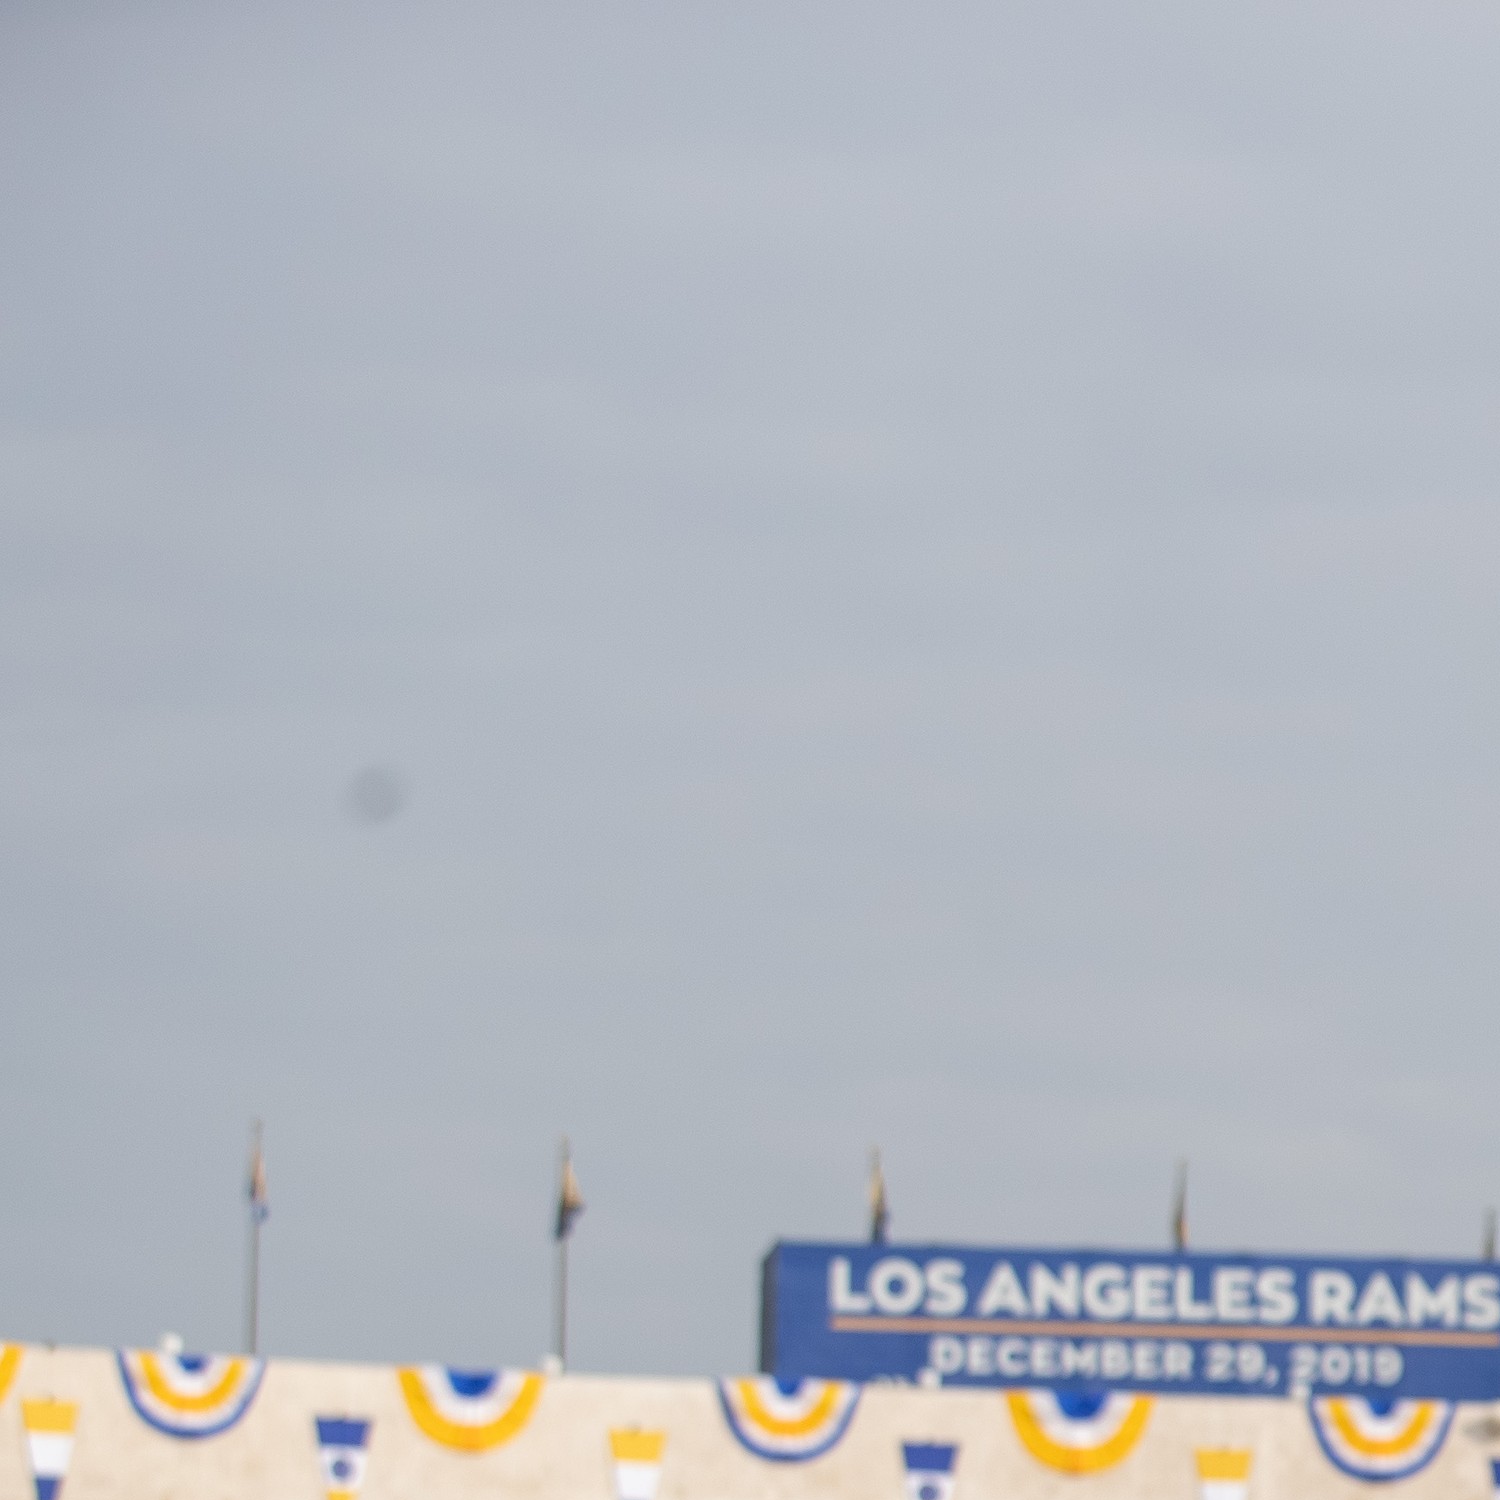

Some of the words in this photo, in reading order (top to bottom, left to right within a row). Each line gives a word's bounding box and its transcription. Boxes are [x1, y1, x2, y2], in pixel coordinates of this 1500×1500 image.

[829, 1257, 965, 1316] LOS
[979, 1261, 1298, 1325] ANGELES
[931, 1337, 1194, 1381] DECEMBER
[1207, 1342, 1279, 1388] 29,
[1291, 1345, 1404, 1388] 2019
